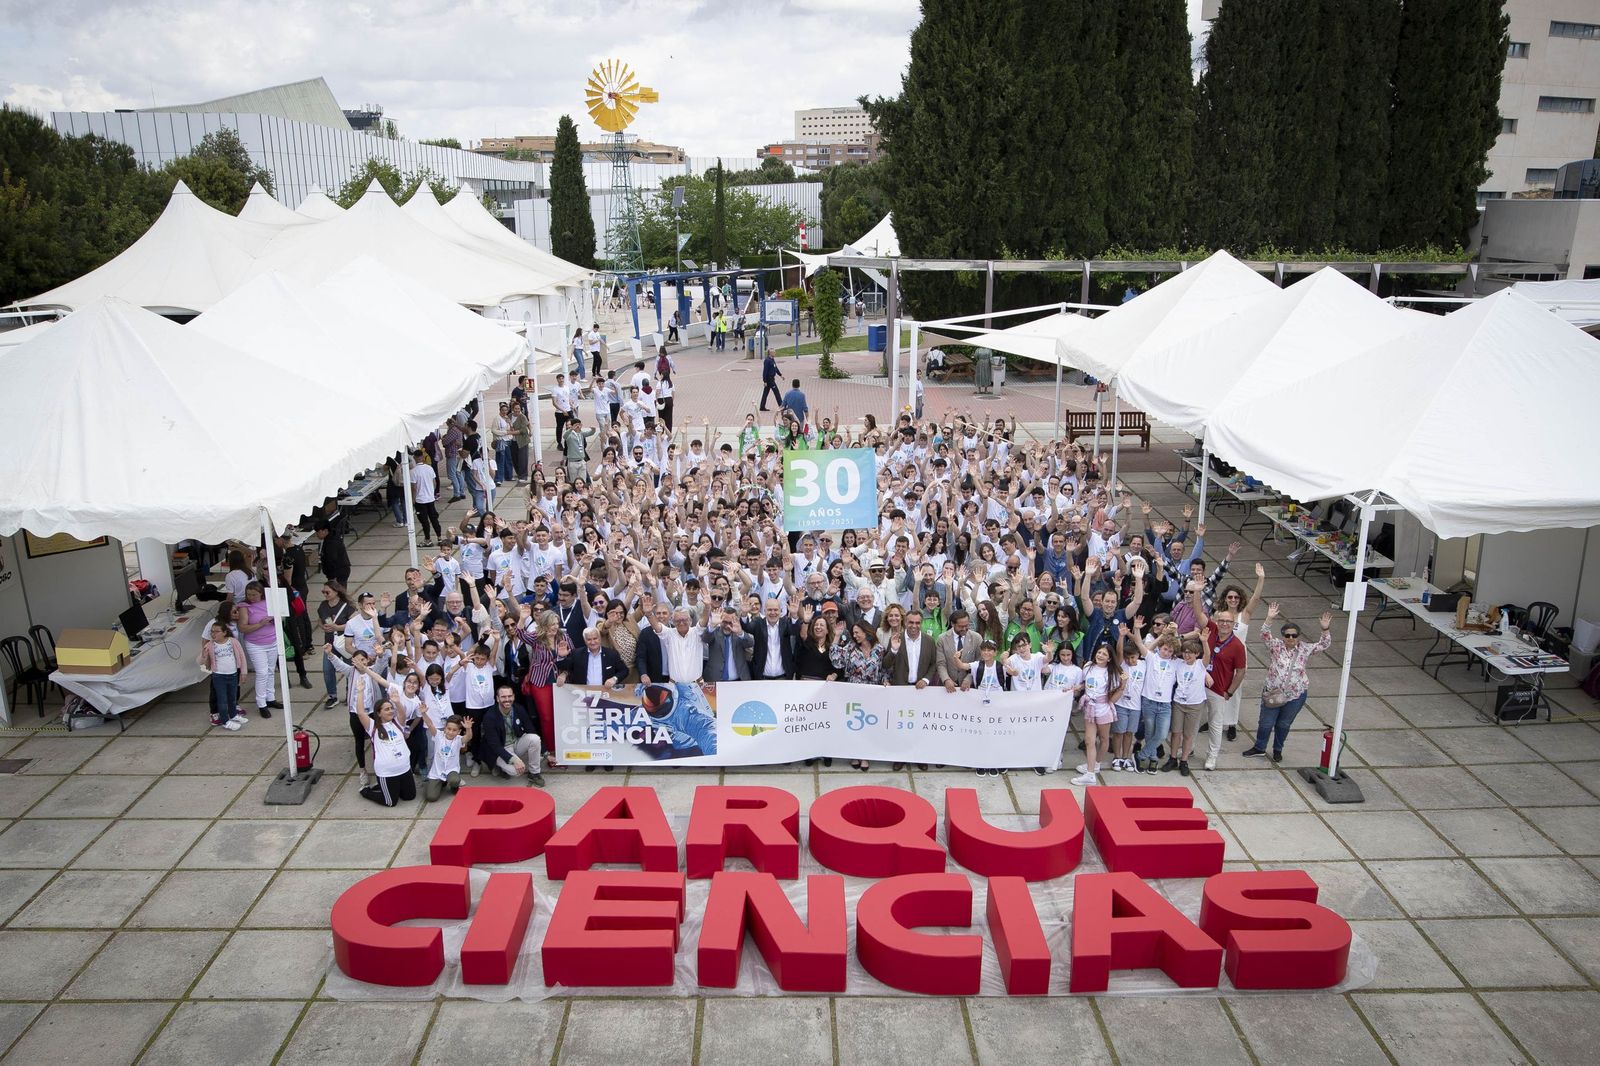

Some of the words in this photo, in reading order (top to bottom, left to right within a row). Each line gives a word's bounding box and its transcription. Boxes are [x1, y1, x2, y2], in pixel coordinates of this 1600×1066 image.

[789, 458, 861, 507] 30
[809, 507, 842, 518] AÑOS
[784, 701, 828, 712] PARQUE
[572, 707, 653, 725] FERIA
[898, 710, 915, 718] 15
[922, 711, 982, 724] MILLONES
[1009, 715, 1056, 724] VISITAS
[784, 721, 831, 734] CIENCIAS
[896, 721, 915, 730] 30
[922, 723, 955, 732] AÑOS
[561, 725, 673, 745] CIENCIA
[430, 786, 1226, 882] PARQUE
[330, 865, 1353, 996] CIENCIAS
